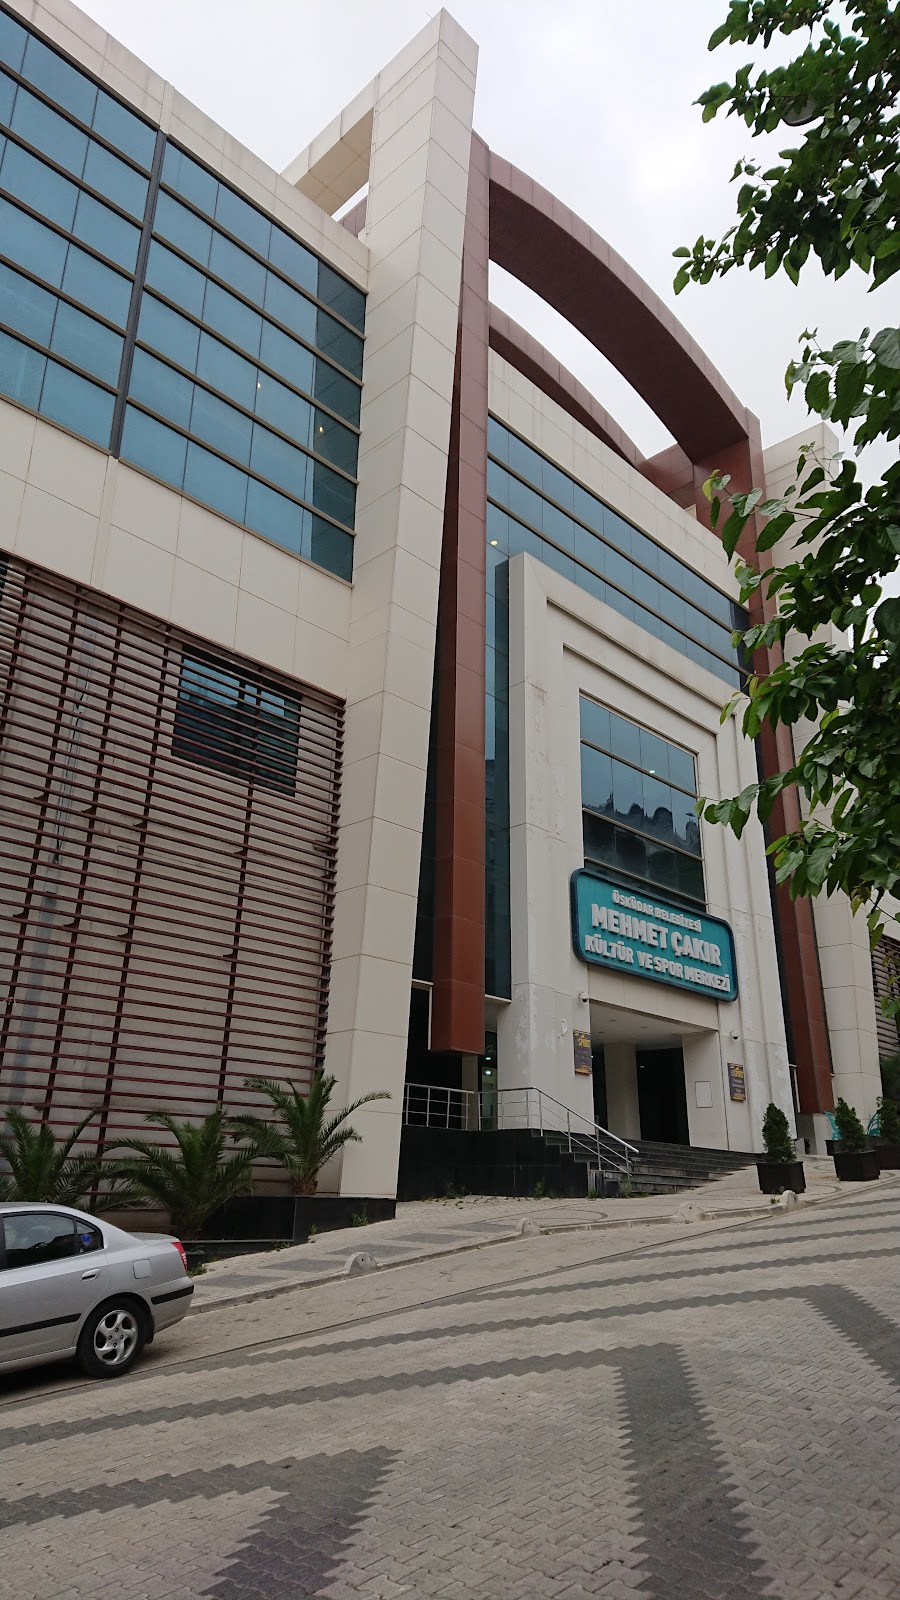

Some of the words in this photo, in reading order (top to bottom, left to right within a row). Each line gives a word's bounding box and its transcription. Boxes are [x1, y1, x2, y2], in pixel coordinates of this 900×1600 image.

[591, 904, 668, 949] MEHMET
[671, 931, 722, 966] ÇAKIR
[612, 890, 654, 915] ÜSKÜDAR
[654, 906, 702, 933] BELEDİYESİ
[584, 934, 634, 964] KÜLTÜR
[637, 951, 653, 970] VE
[653, 957, 684, 979] SPOR
[684, 966, 731, 992] MERKEZİ
